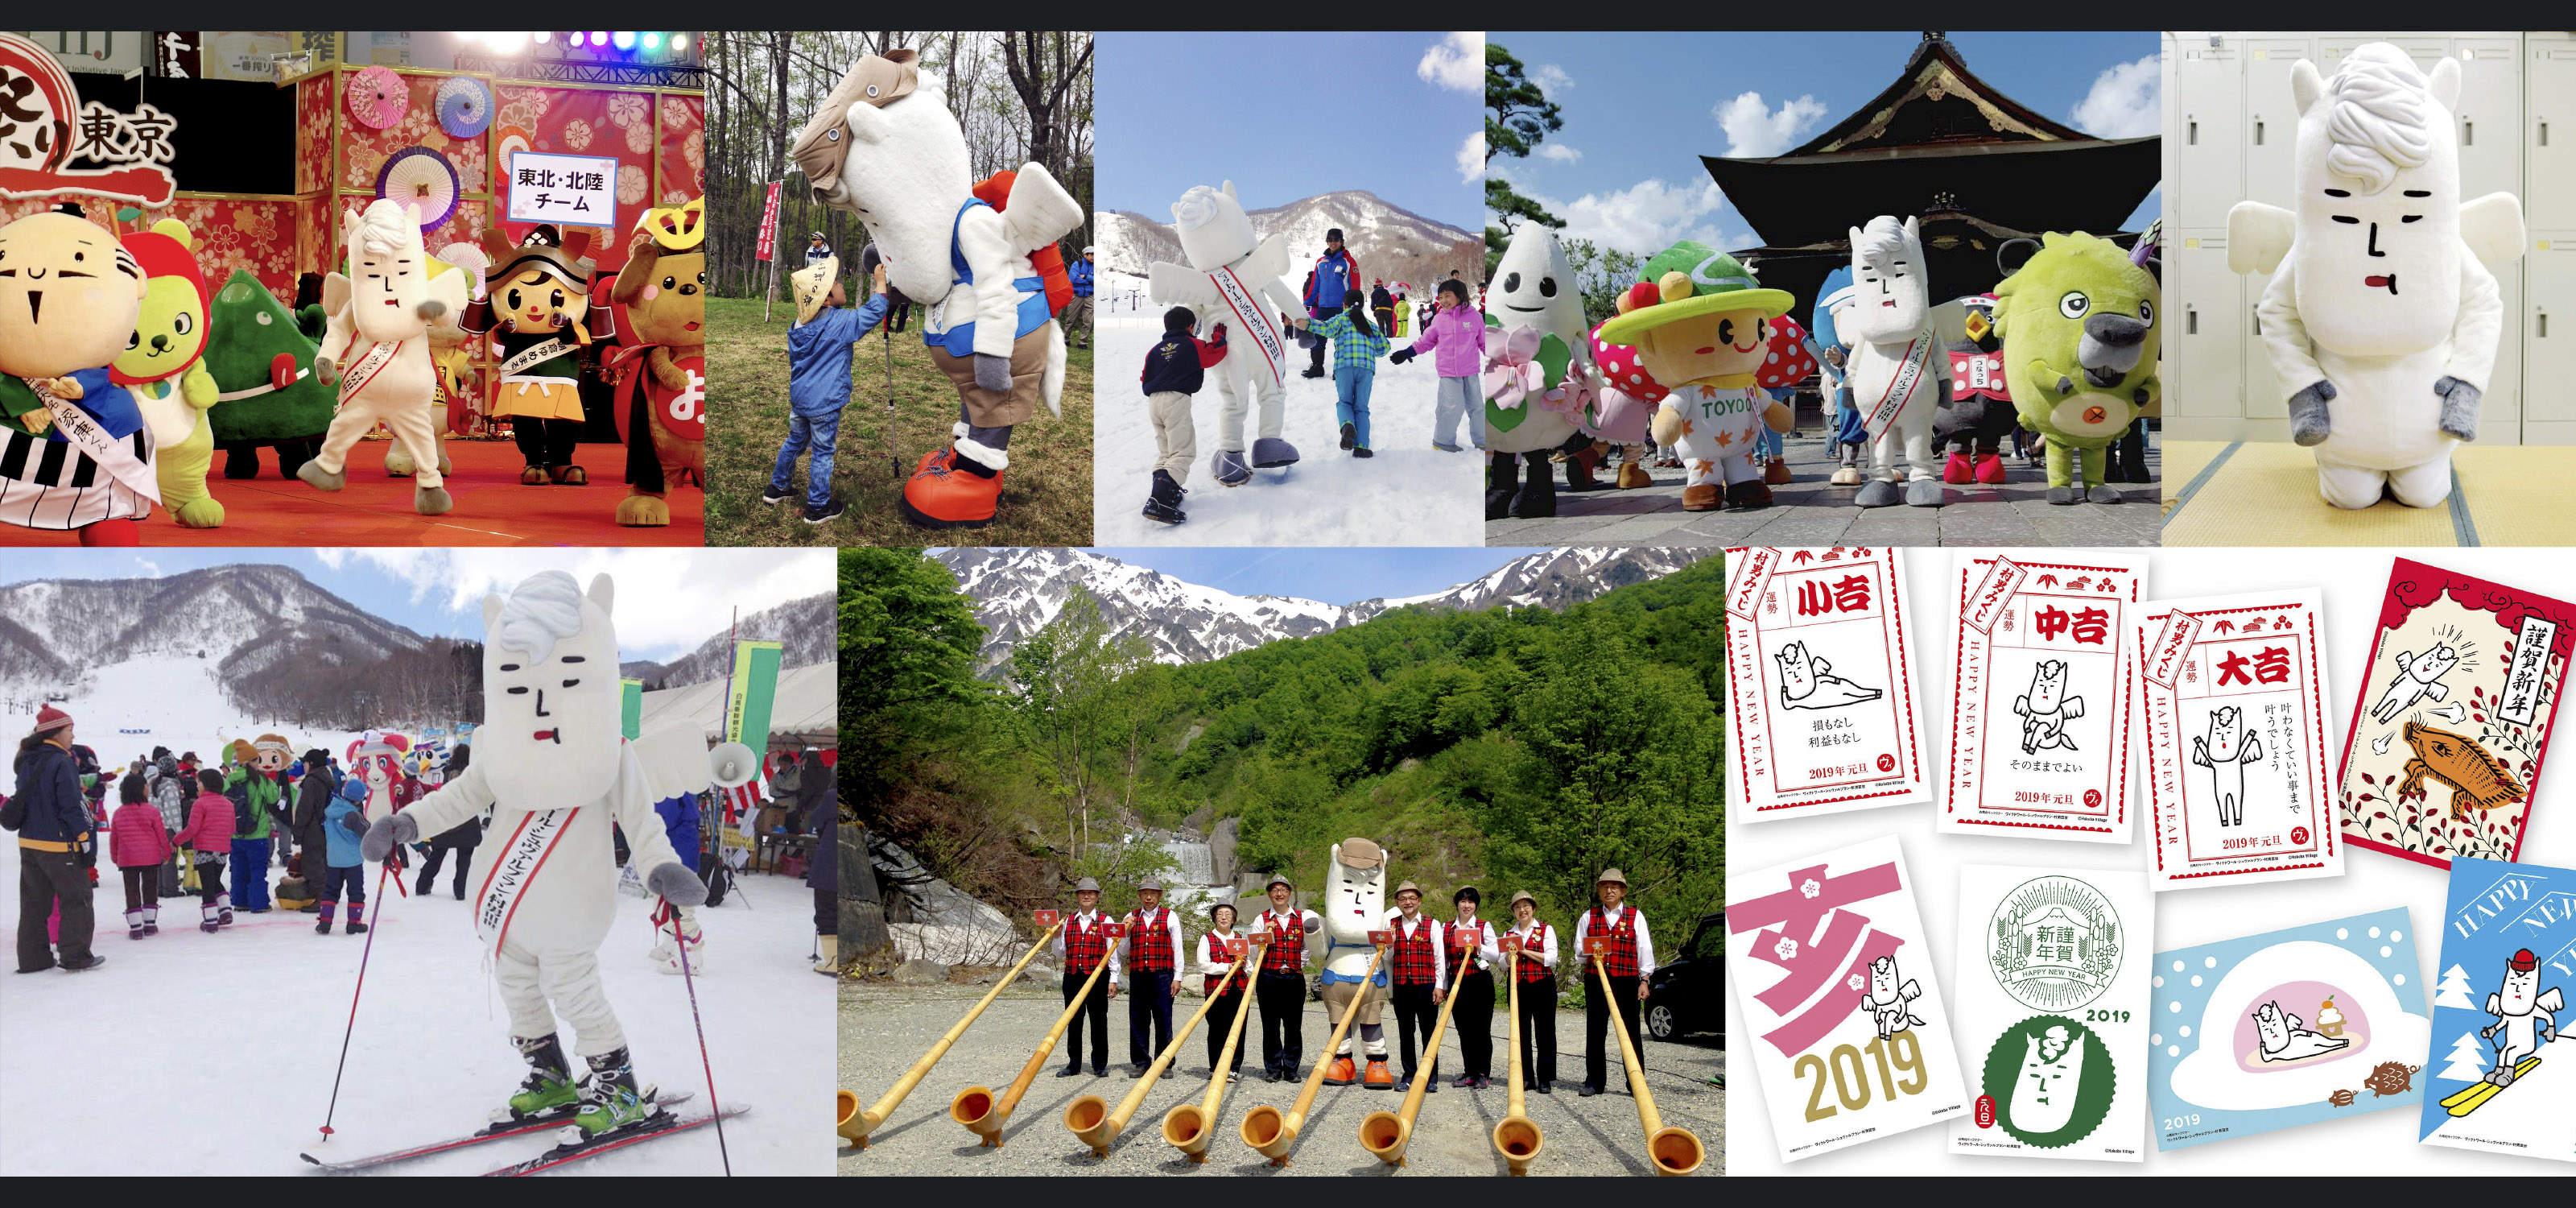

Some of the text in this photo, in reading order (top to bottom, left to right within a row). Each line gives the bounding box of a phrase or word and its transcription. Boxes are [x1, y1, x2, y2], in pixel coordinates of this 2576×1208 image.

[232, 60, 271, 72] 一番搾り
[74, 106, 172, 158] 東京
[518, 168, 604, 191] 東北・北陸
[535, 193, 590, 213] チーム
[1737, 551, 1768, 610] 村男みくじ
[1798, 574, 1871, 616] 小吉
[1975, 567, 2016, 623] 村男みくじ
[1766, 591, 1777, 614] 運勢
[2003, 609, 2015, 631] 運勢
[2035, 604, 2108, 644] 中吉
[2157, 619, 2190, 677] 村男みくじ
[2216, 646, 2291, 686] 大吉
[2186, 660, 2198, 683] 運勢
[2505, 624, 2548, 716] 謹賀新年
[1739, 629, 1764, 776] HAPPY NEW YEAR
[1962, 640, 1980, 789] HAPPY NEW YEAR
[1808, 733, 1861, 748] 利益もなし
[1812, 718, 1854, 732] 損もなし
[2264, 704, 2280, 772] 叶うでしょう
[2010, 759, 2083, 773] そのままでよい
[2157, 697, 2178, 845] HAPPY NEW YEAR
[2280, 702, 2301, 813] 叶わなくていい事まで
[2453, 879, 2537, 941] HAPPY
[2022, 969, 2047, 978] HAPPY
[2068, 970, 2086, 980] YEAR
[2087, 1009, 2131, 1023] 2019
[1794, 1029, 1928, 1123] 2019
[2164, 1114, 2201, 1131] 2019
